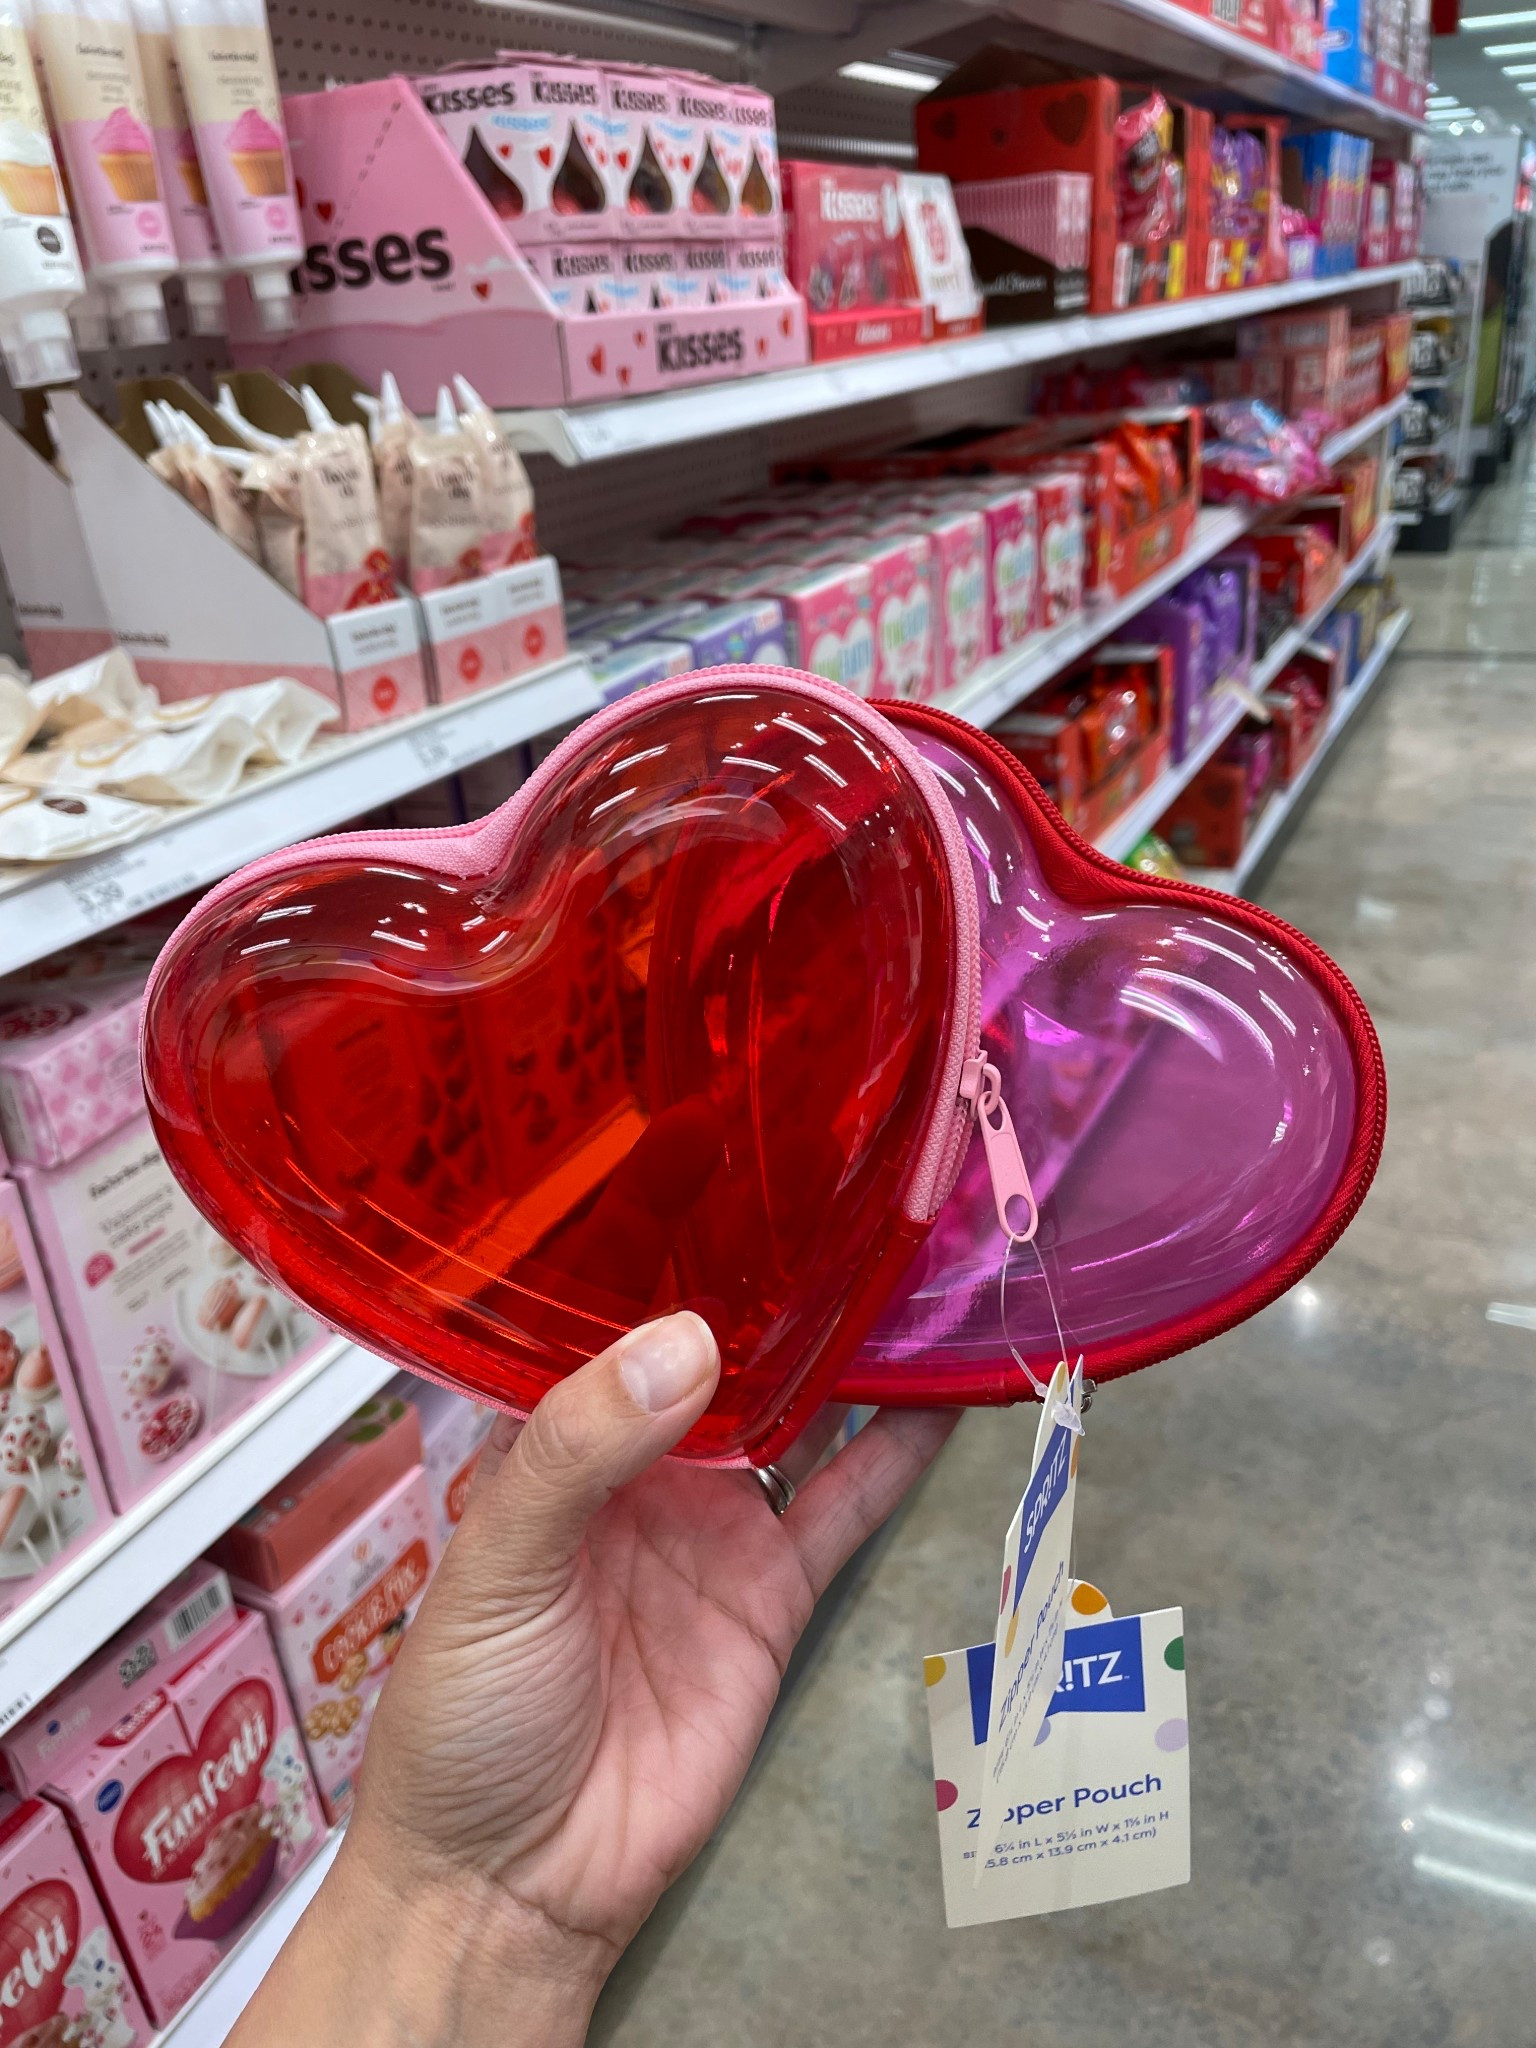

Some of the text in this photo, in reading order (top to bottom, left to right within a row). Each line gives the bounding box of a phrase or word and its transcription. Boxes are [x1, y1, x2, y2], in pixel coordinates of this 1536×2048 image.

[140, 1711, 268, 1870] Funfetti
[1074, 1774, 1162, 1808] Pouch
[1019, 1840, 1030, 1849] in
[1035, 1838, 1042, 1846] L
[1081, 1828, 1092, 1837] in
[1096, 1823, 1109, 1834] W
[1144, 1814, 1155, 1824] in
[1160, 1811, 1169, 1821] H
[1012, 1855, 1032, 1864] cm
[1077, 1842, 1096, 1851] cm
